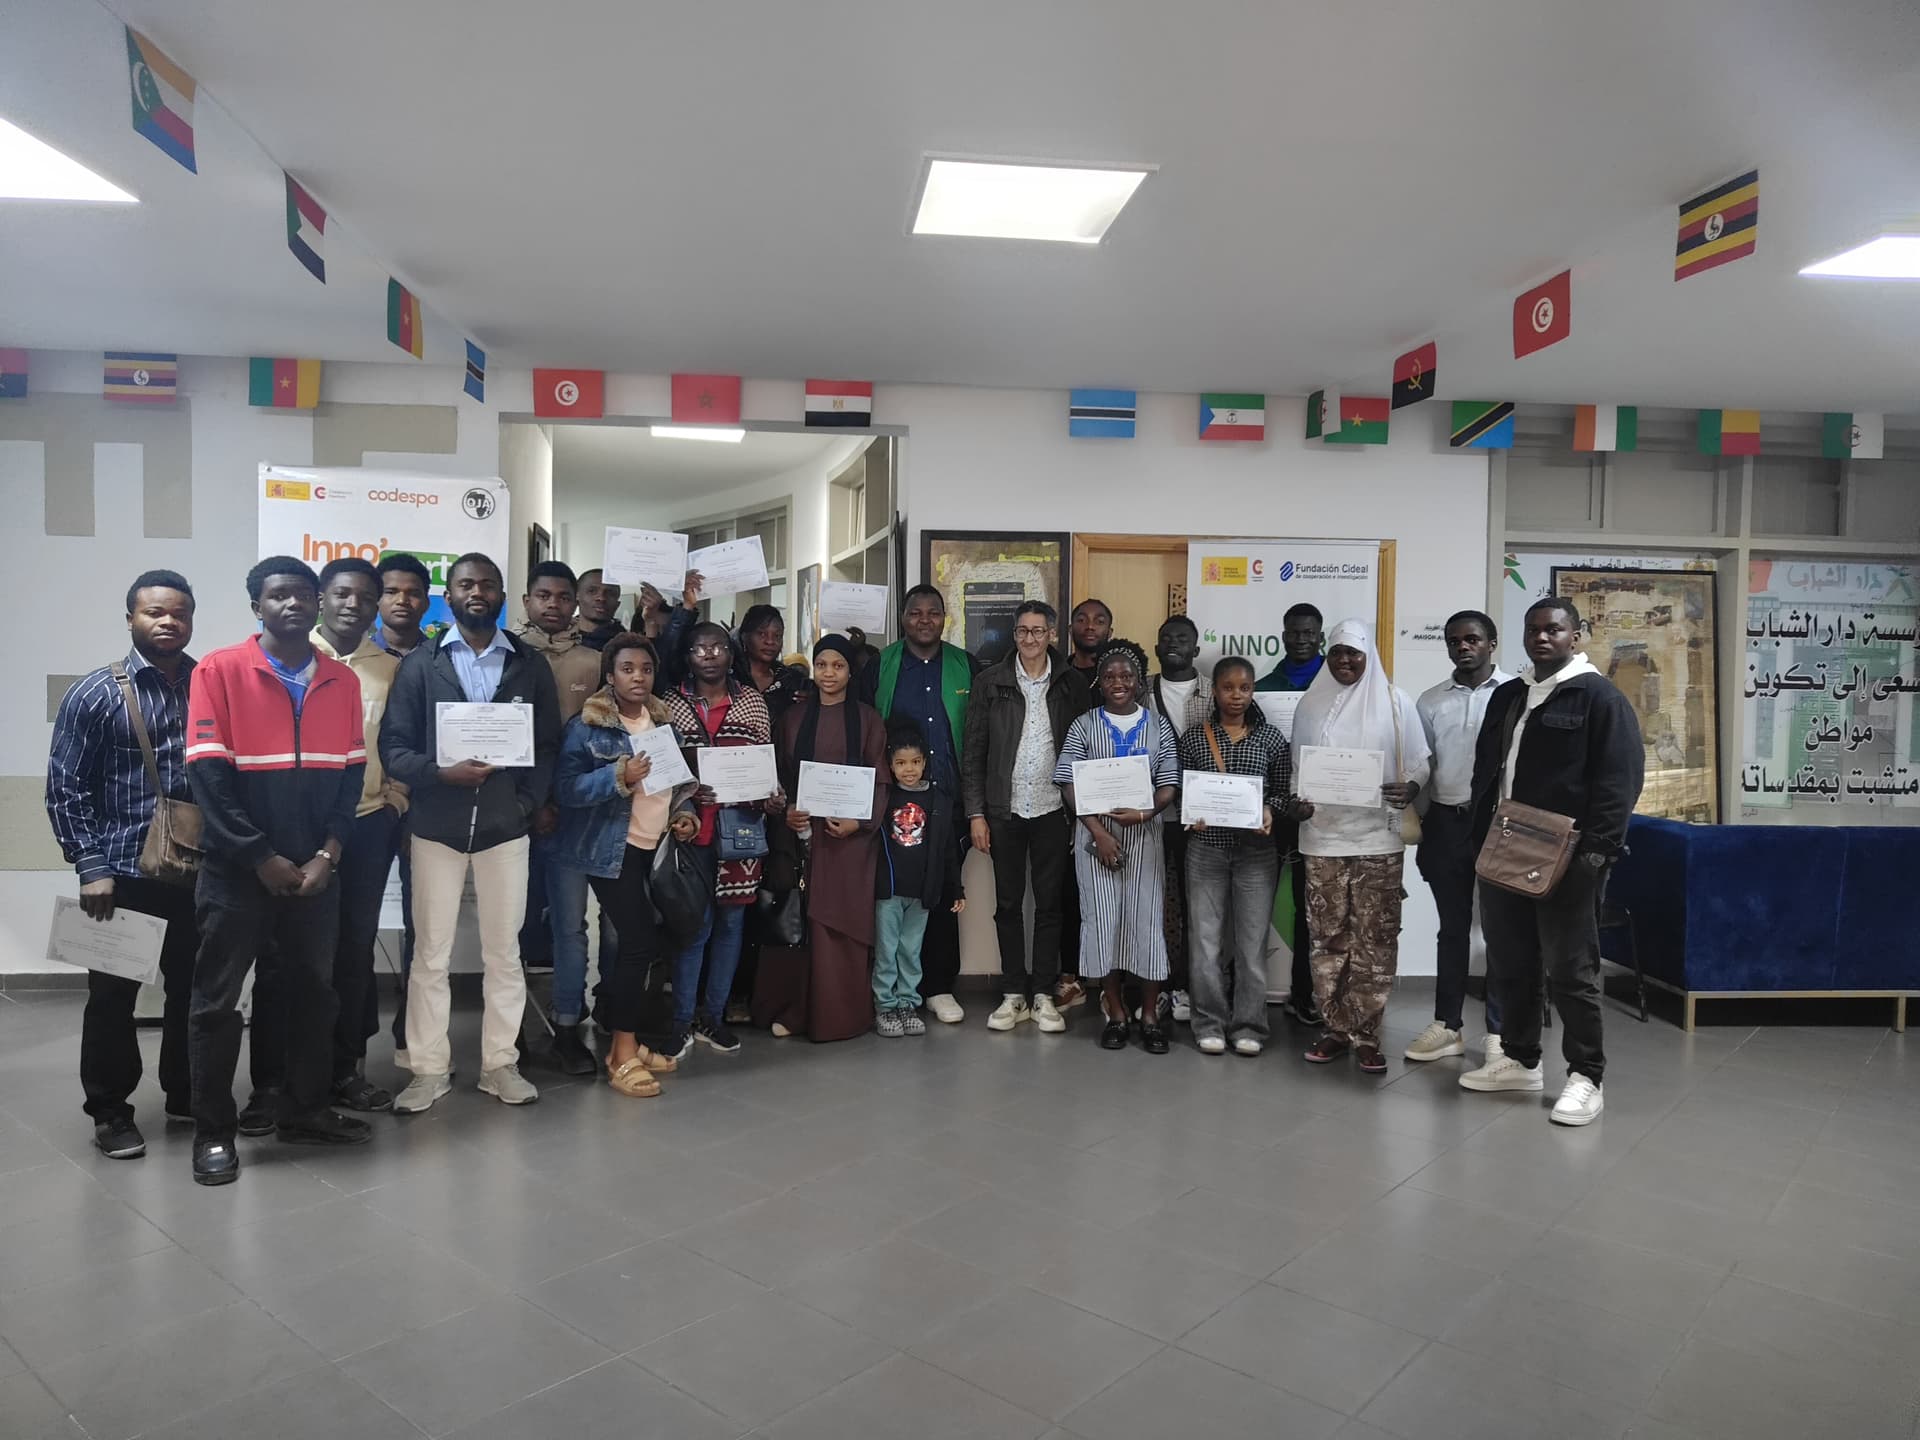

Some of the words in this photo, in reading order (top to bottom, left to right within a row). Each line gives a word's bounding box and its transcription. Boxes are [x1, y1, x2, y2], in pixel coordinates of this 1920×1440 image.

[368, 488, 438, 507] codespa
[1295, 563, 1339, 573] Fundación
[1342, 564, 1369, 573] Cideal
[1787, 565, 1847, 592] الشباب
[1746, 610, 1818, 647] الشباب
[1820, 613, 1856, 647] دار
[1744, 662, 1827, 698] تكوين
[1833, 664, 1867, 701] إلى
[1805, 715, 1873, 751] مواطن
